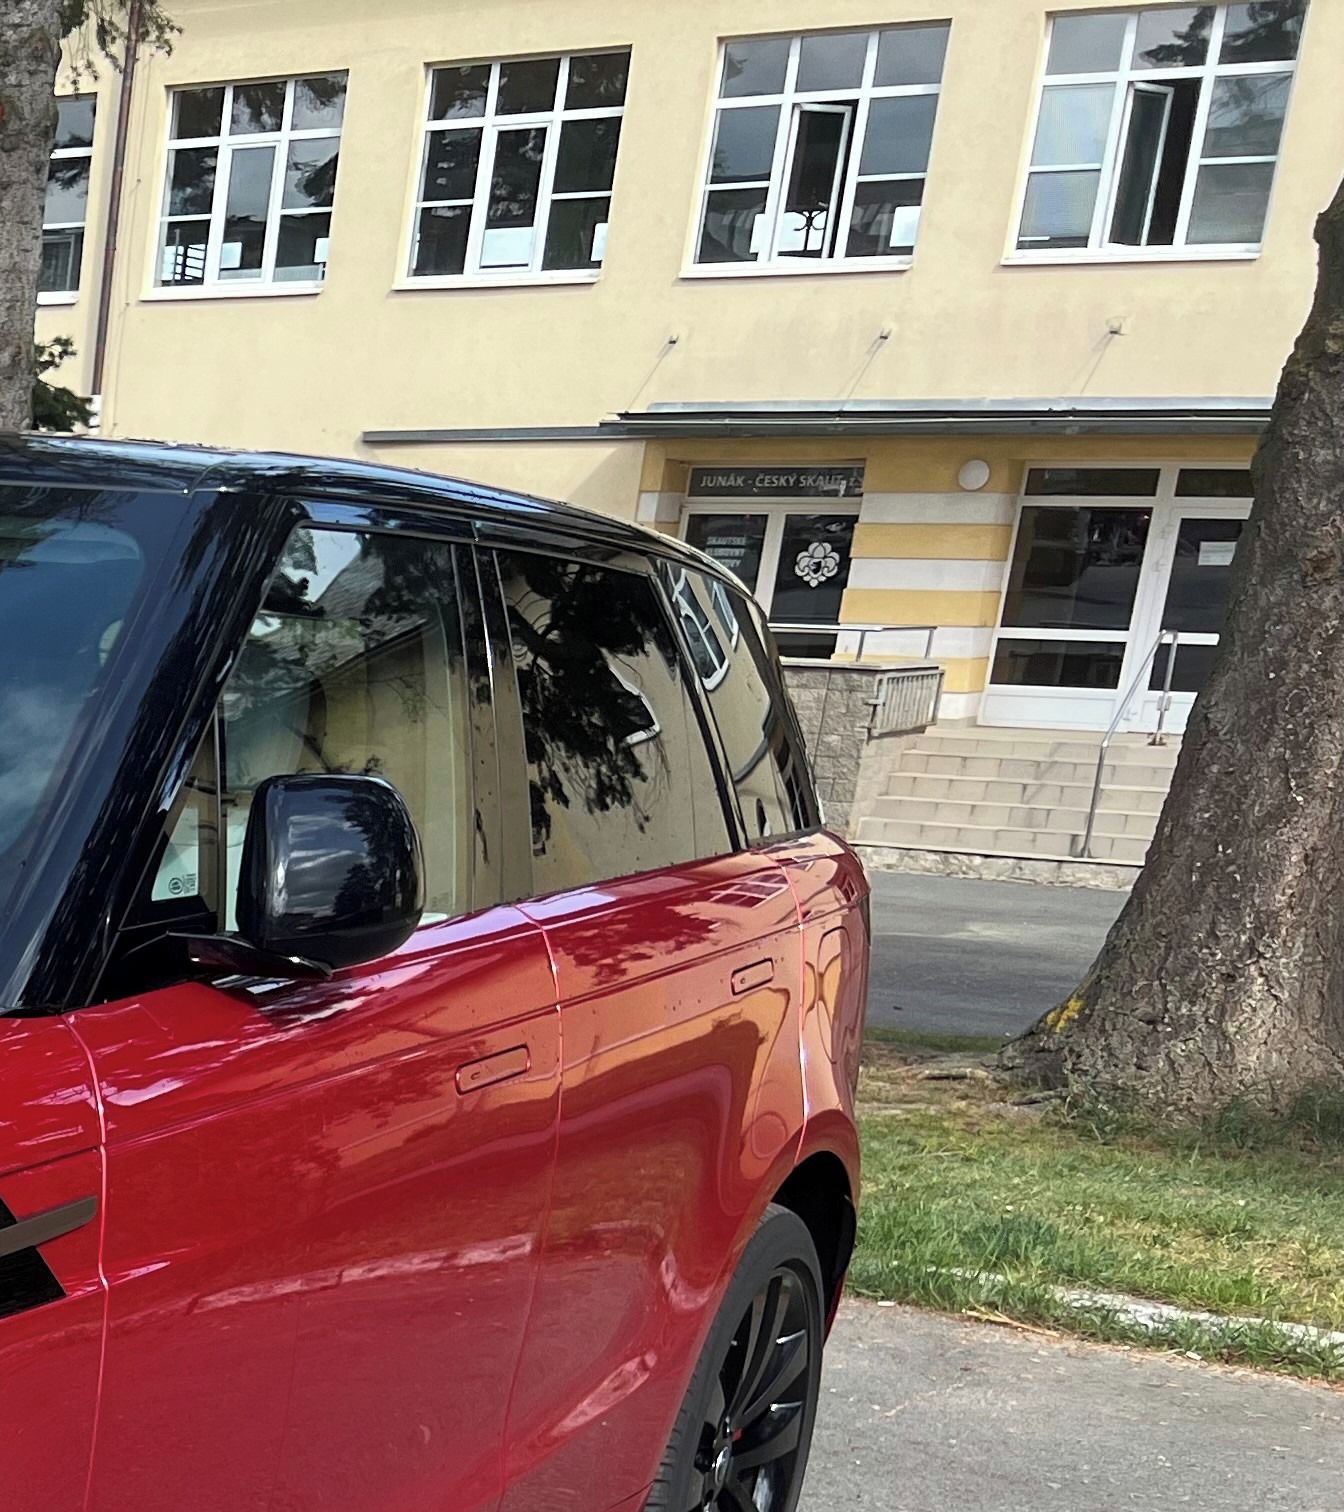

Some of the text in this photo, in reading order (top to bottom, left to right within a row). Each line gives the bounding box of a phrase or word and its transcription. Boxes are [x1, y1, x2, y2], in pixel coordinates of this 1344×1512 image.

[700, 473, 745, 487] JUNÁK
[754, 472, 797, 487] ČESKÝ
[799, 474, 844, 487] SKAUT
